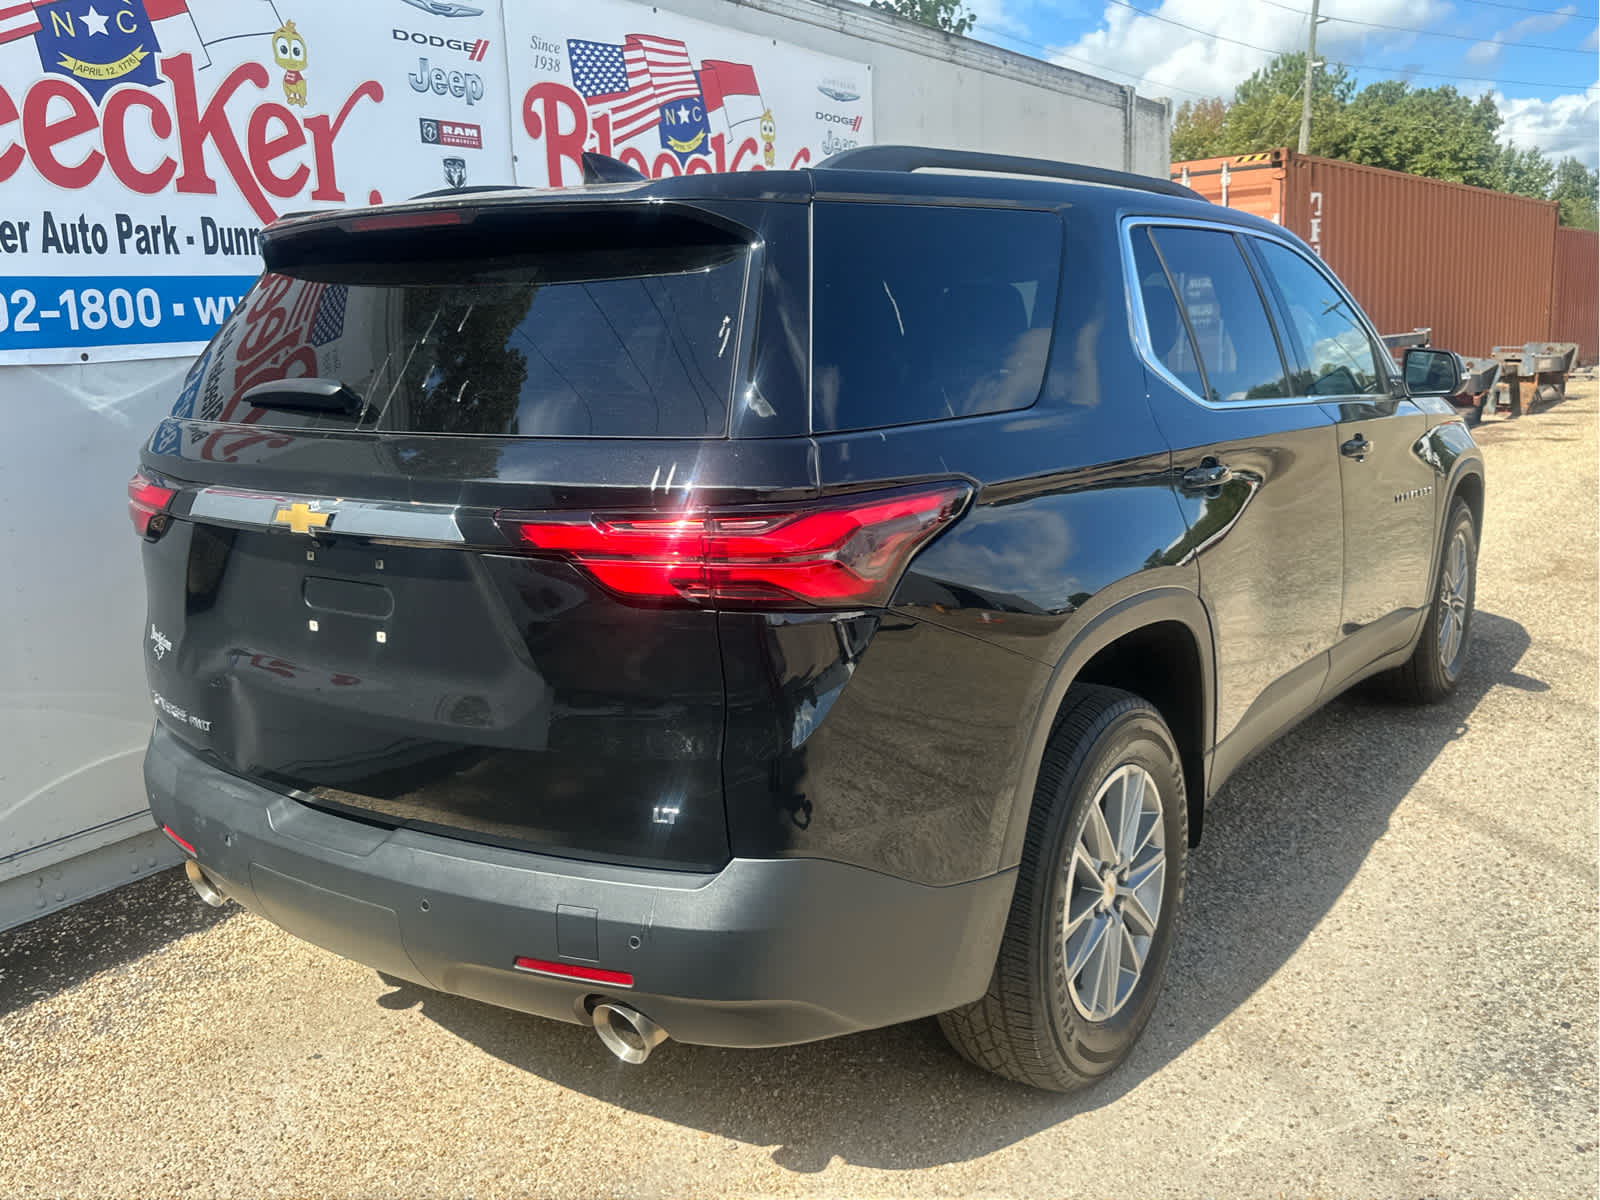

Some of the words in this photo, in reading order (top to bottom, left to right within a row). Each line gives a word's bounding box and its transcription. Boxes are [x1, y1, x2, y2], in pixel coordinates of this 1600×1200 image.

[50, 10, 76, 38] N
[115, 9, 138, 34] C
[392, 29, 478, 53] DODGE
[530, 35, 560, 54] Since
[75, 64, 104, 76] APRIL
[118, 57, 137, 71] 1776
[534, 54, 560, 73] 1938
[407, 57, 484, 106] Jeep
[665, 108, 677, 126] N
[692, 106, 703, 122] C
[815, 111, 857, 127] DODGE
[442, 125, 478, 137] RAM
[42, 211, 108, 255] Auto
[115, 213, 181, 255] Park
[652, 807, 680, 824] LT
